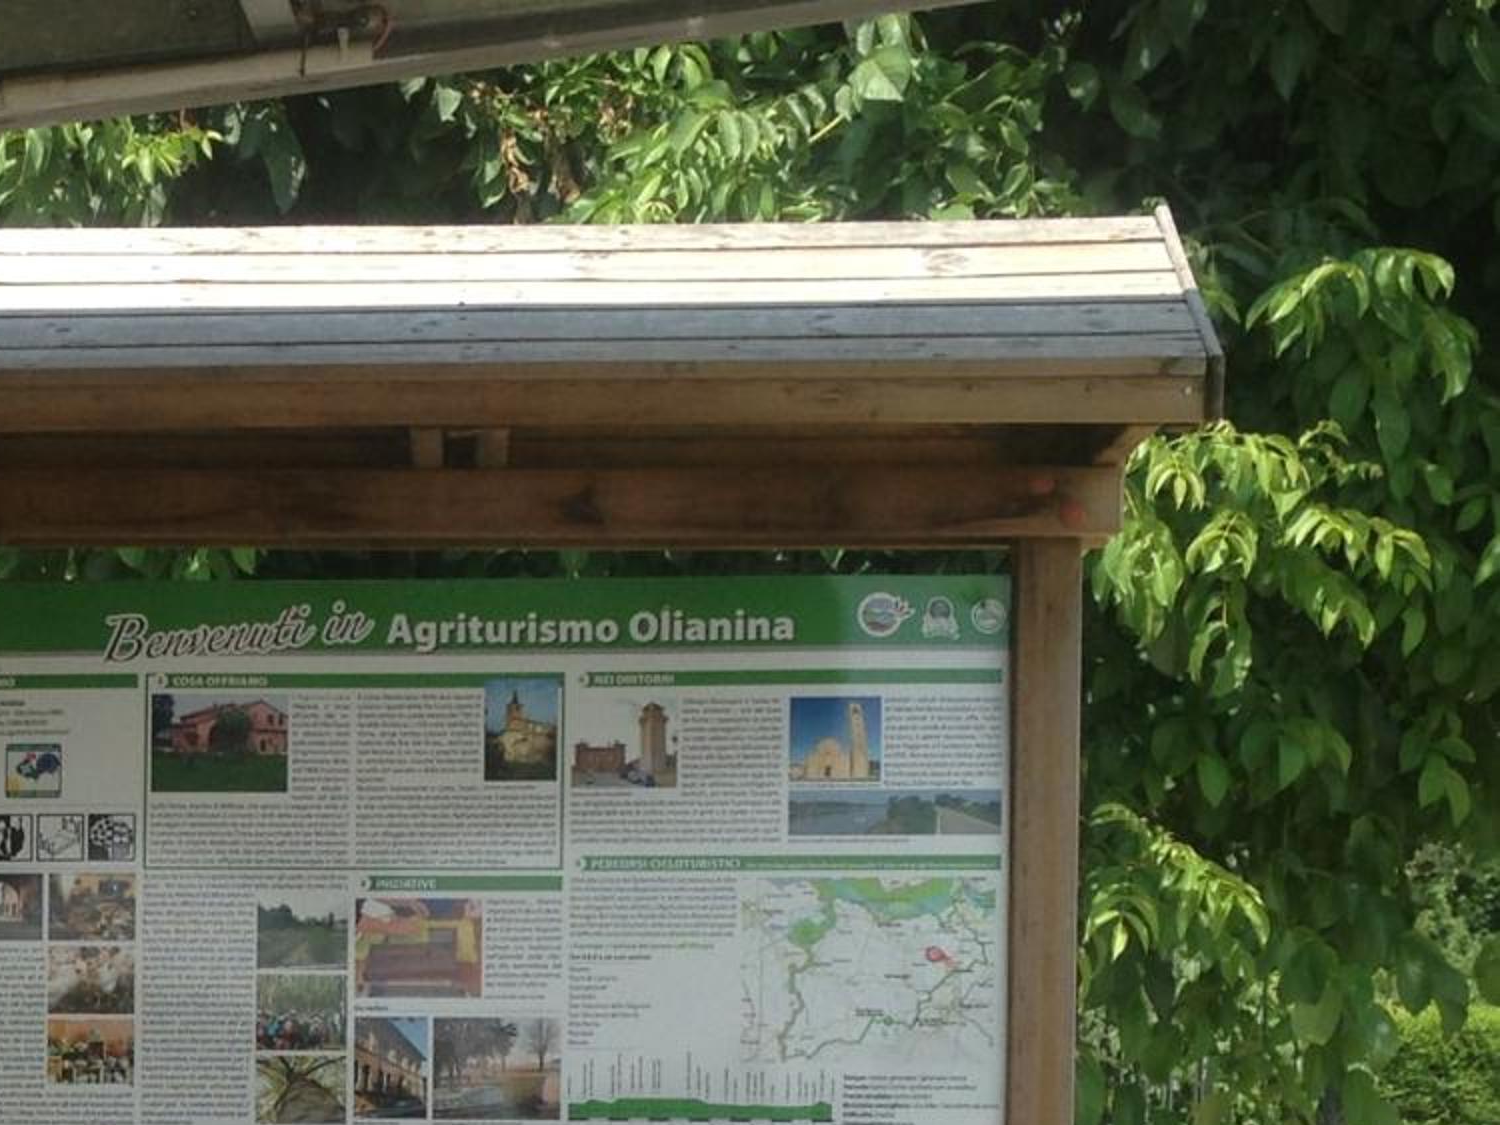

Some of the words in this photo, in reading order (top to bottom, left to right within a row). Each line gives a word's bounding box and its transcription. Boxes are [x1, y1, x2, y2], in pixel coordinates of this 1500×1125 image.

[104, 604, 317, 662] Benvenuti
[321, 600, 375, 645] in
[387, 612, 618, 652] Agriturismo
[629, 606, 795, 643] Olianina
